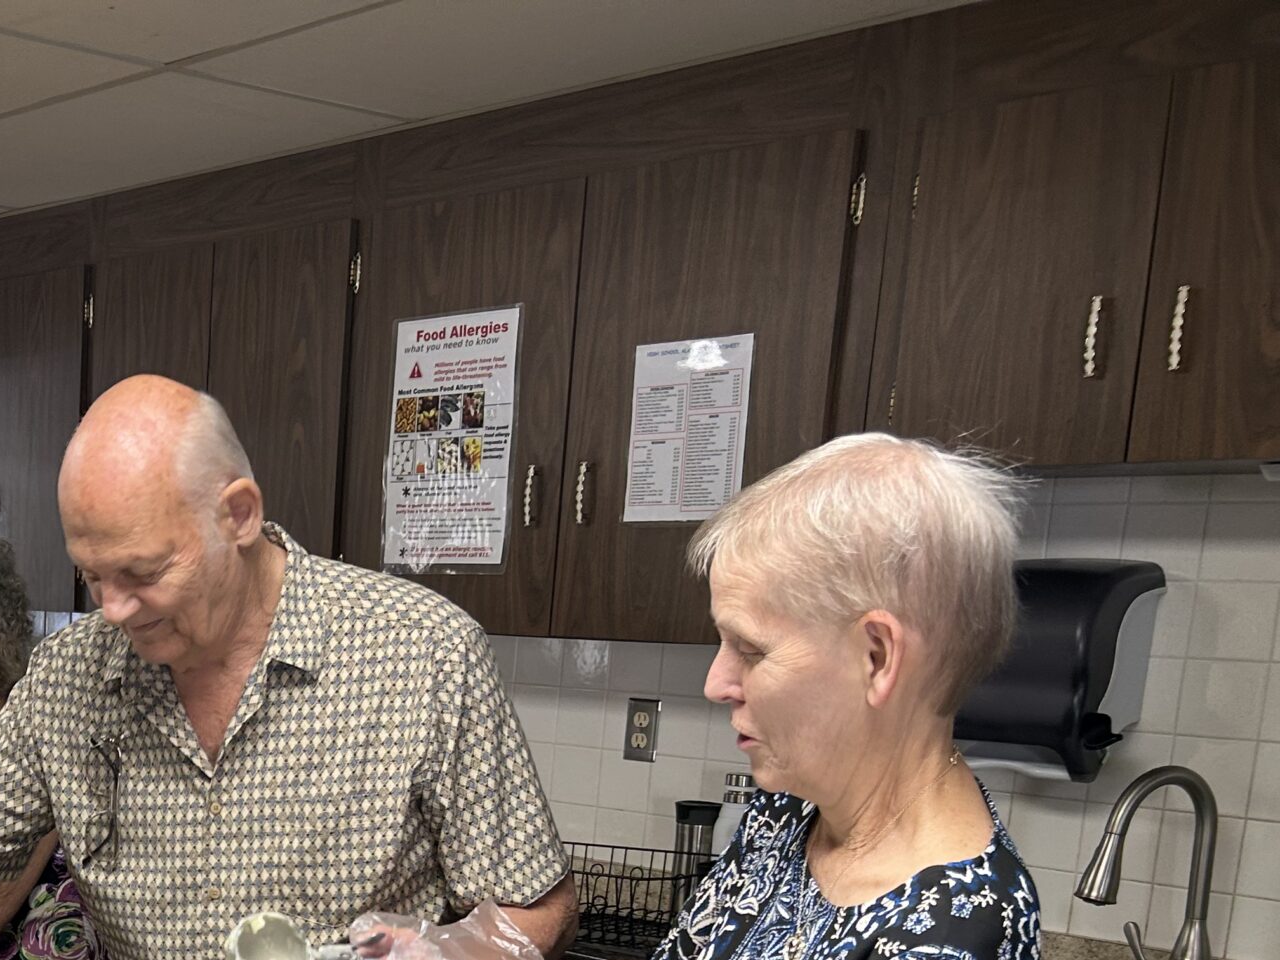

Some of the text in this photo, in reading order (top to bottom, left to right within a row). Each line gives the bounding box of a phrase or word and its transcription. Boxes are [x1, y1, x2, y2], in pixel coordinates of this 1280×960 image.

[416, 321, 509, 342] Food Allergies
[404, 336, 499, 354] what you need to know
